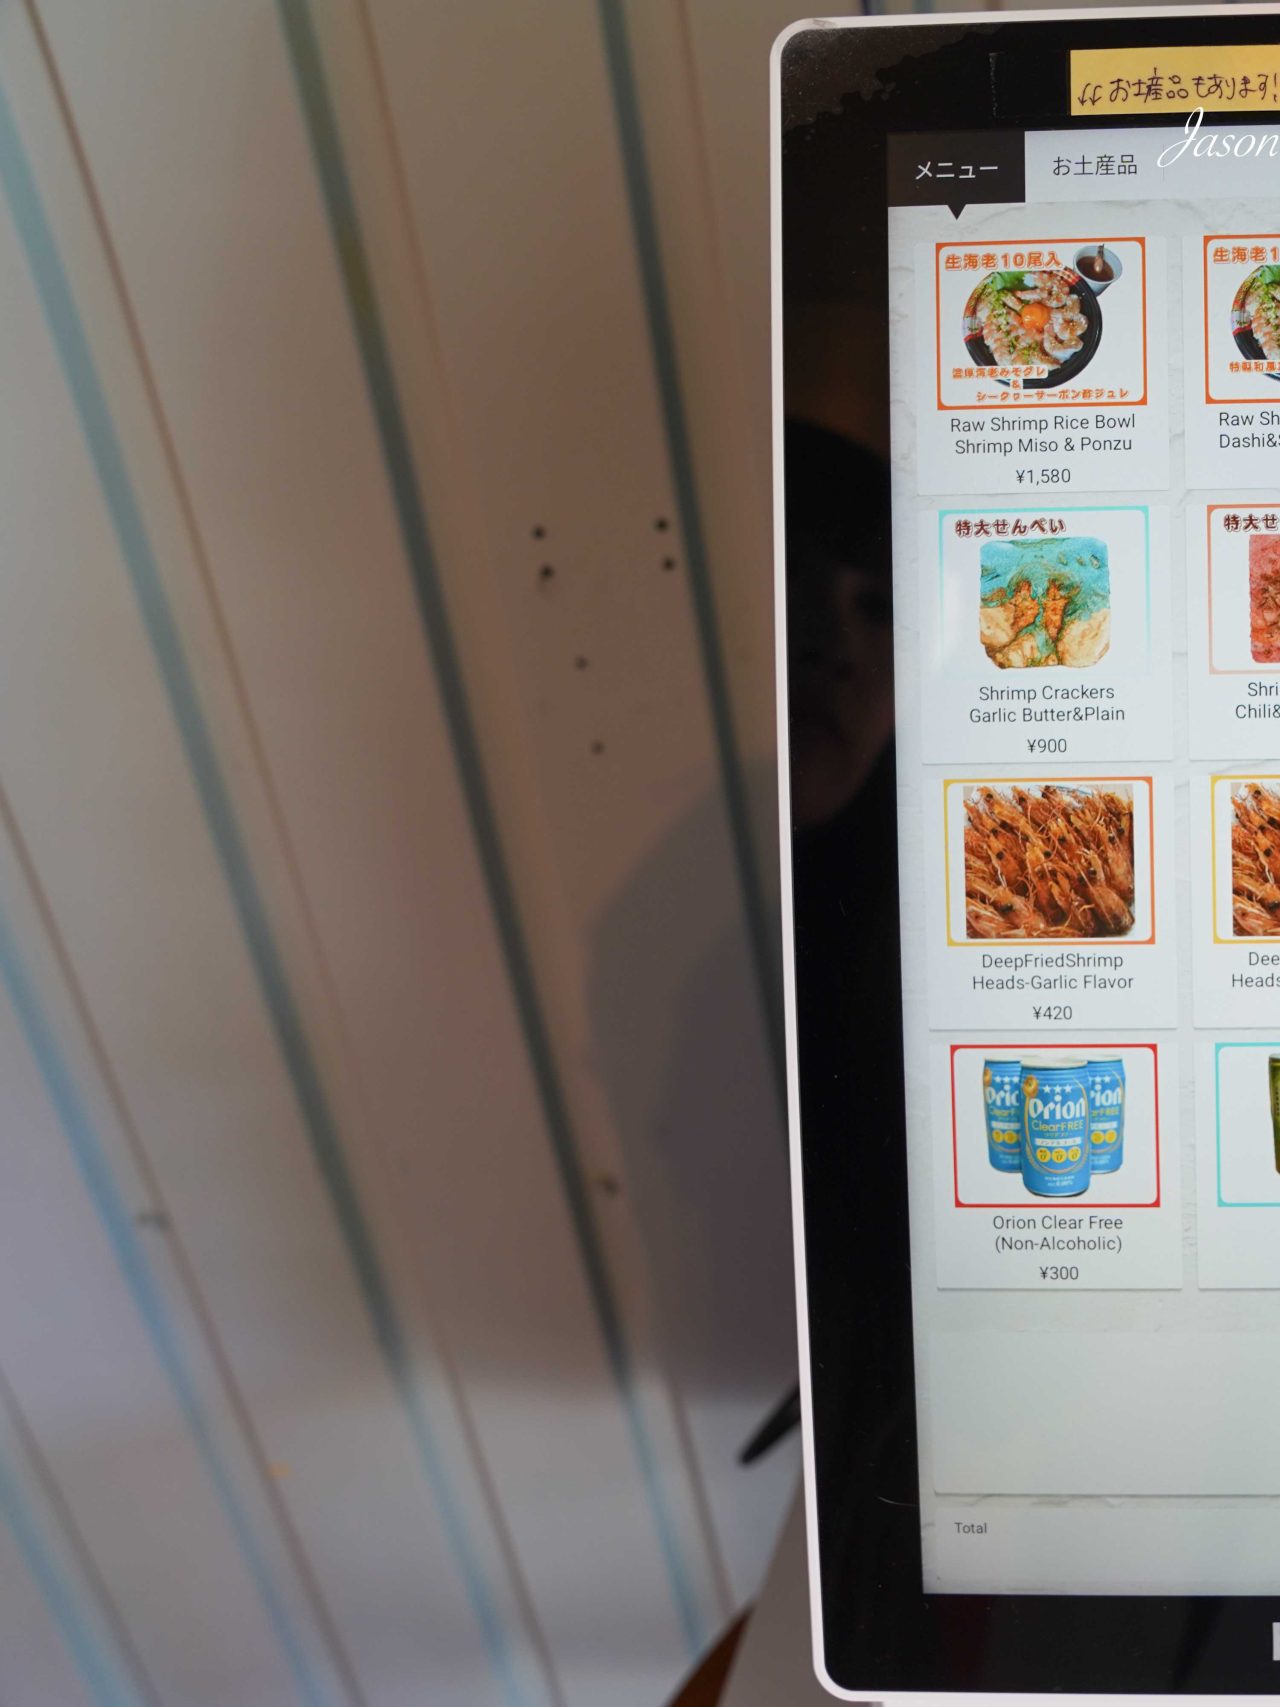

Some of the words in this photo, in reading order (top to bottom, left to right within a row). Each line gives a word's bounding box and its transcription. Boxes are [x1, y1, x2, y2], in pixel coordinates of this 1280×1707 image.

[915, 160, 999, 180] メニュー
[1052, 154, 1138, 177] お土産品
[945, 252, 1062, 270] 生海老10尾入
[951, 418, 985, 433] Raw
[990, 416, 1049, 434] Shrimp
[1054, 415, 1090, 430] Rice
[1095, 413, 1136, 429] Bowl
[1219, 412, 1255, 427] Raw
[955, 439, 1013, 457] Shrimp
[1018, 438, 1058, 453] Miso
[1063, 437, 1076, 452] &
[1080, 436, 1133, 451] Ponzu
[1015, 468, 1071, 487] ¥1,580
[954, 518, 1067, 538] 特大せんべい
[979, 685, 1038, 703] Shrimp
[1042, 684, 1115, 700] Crackers
[969, 708, 1017, 724] Garlic
[1022, 706, 1126, 723] Butter&Plain
[1026, 737, 1068, 754] ¥900
[981, 953, 1124, 971] DeepFriedShrimp
[972, 975, 1078, 990] Heads-Garlic
[1083, 974, 1134, 989] Flavor
[1033, 1005, 1073, 1021] ¥420
[1028, 1094, 1086, 1120] Orion
[993, 1215, 1037, 1230] Orion
[1041, 1215, 1084, 1230] Clear
[1089, 1214, 1124, 1230] Free
[995, 1235, 1123, 1254] (Non-Alcoholic)
[1039, 1265, 1080, 1281] ¥300
[954, 1521, 988, 1535] Total
